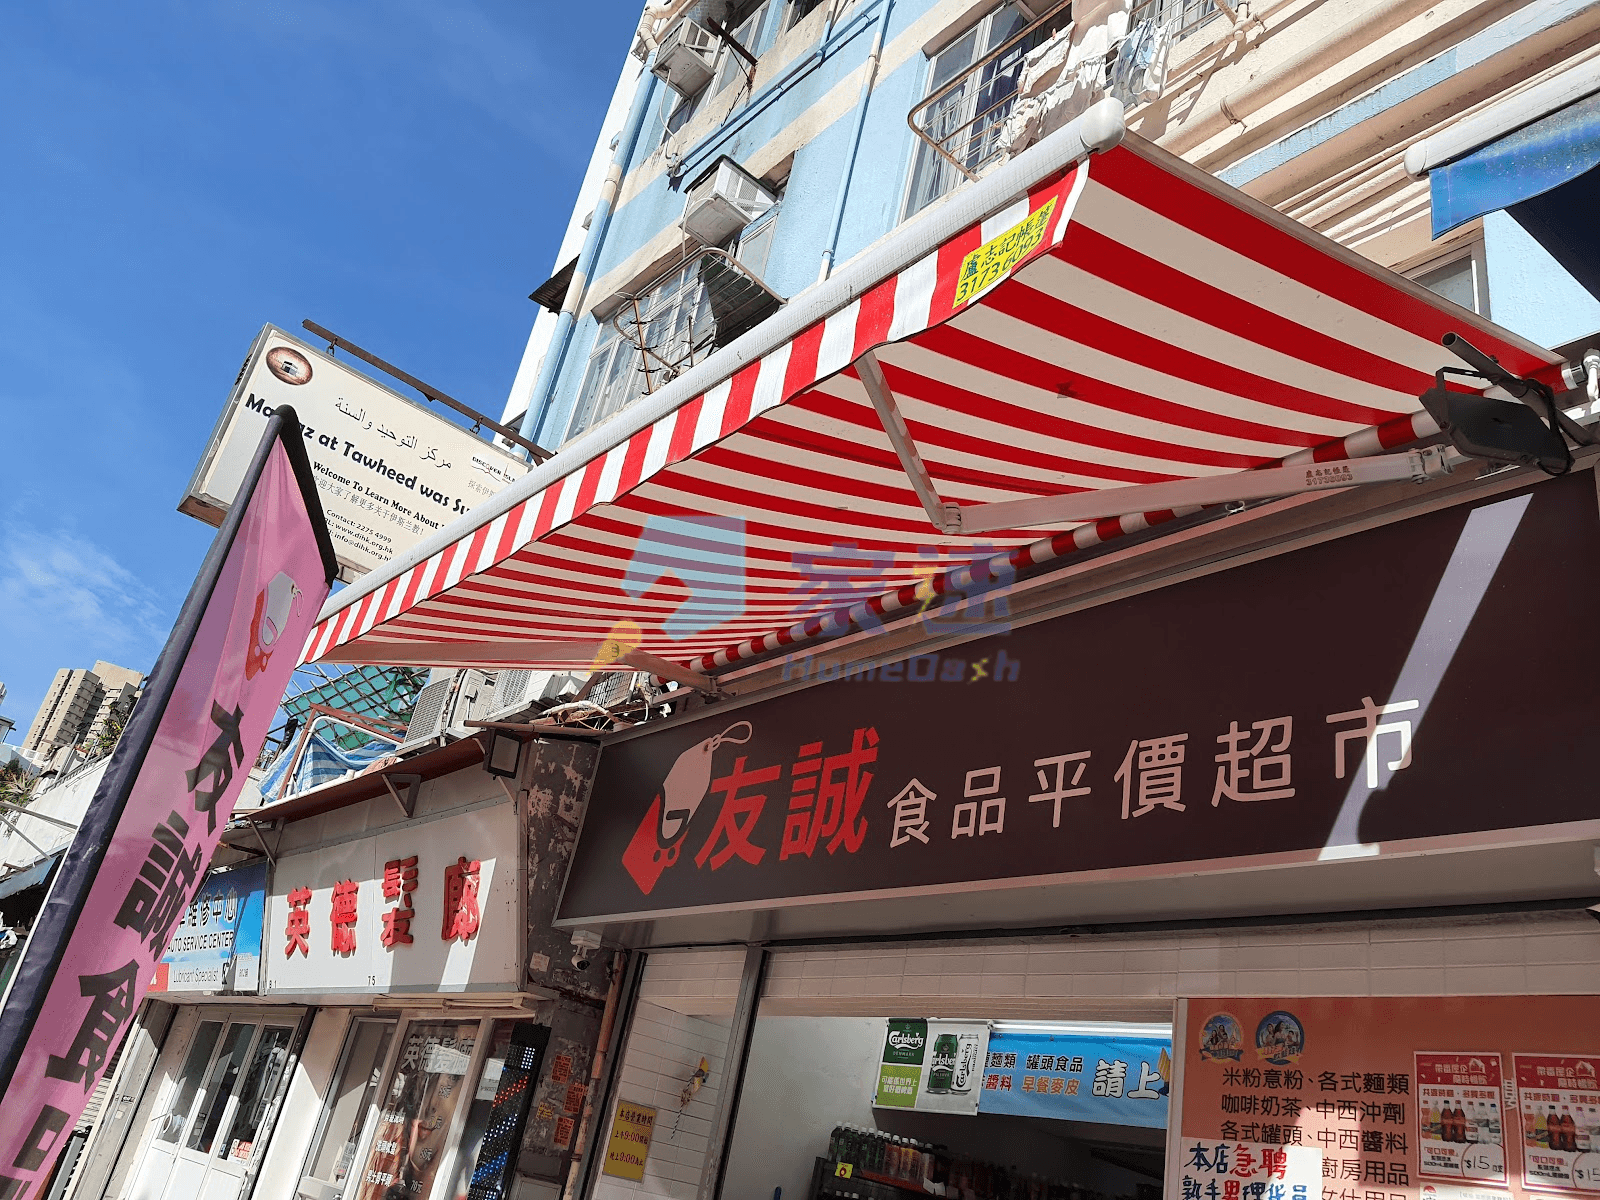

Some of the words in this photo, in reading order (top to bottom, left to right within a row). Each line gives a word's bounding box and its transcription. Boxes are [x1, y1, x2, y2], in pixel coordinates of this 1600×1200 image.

[318, 432, 339, 451] at
[342, 440, 418, 490] Tawheed
[419, 484, 449, 507] was
[313, 461, 351, 486] Welcome
[352, 480, 364, 492] To
[364, 487, 390, 506] Learn
[391, 499, 413, 517] More
[413, 511, 440, 530] About
[326, 509, 356, 527] Contact:
[356, 523, 375, 536] 2275
[374, 532, 393, 544] 4999
[335, 524, 394, 554] www.dihk.org.hk
[182, 933, 207, 952] SERVICE
[208, 931, 234, 950] CENTER
[889, 1030, 924, 1050] Carlsberg
[1026, 1054, 1084, 1074] 罐頭食品
[1021, 1075, 1081, 1096] 早餐麥皮
[1223, 1067, 1410, 1096] 米粉意粉、各式麵類
[1221, 1094, 1406, 1125] 咖啡奶茶、中西沖劑
[1220, 1119, 1409, 1156] 各式罐頭、中西醬料
[1184, 1142, 1288, 1180] 本店急聘
[1466, 1156, 1490, 1170] $15
